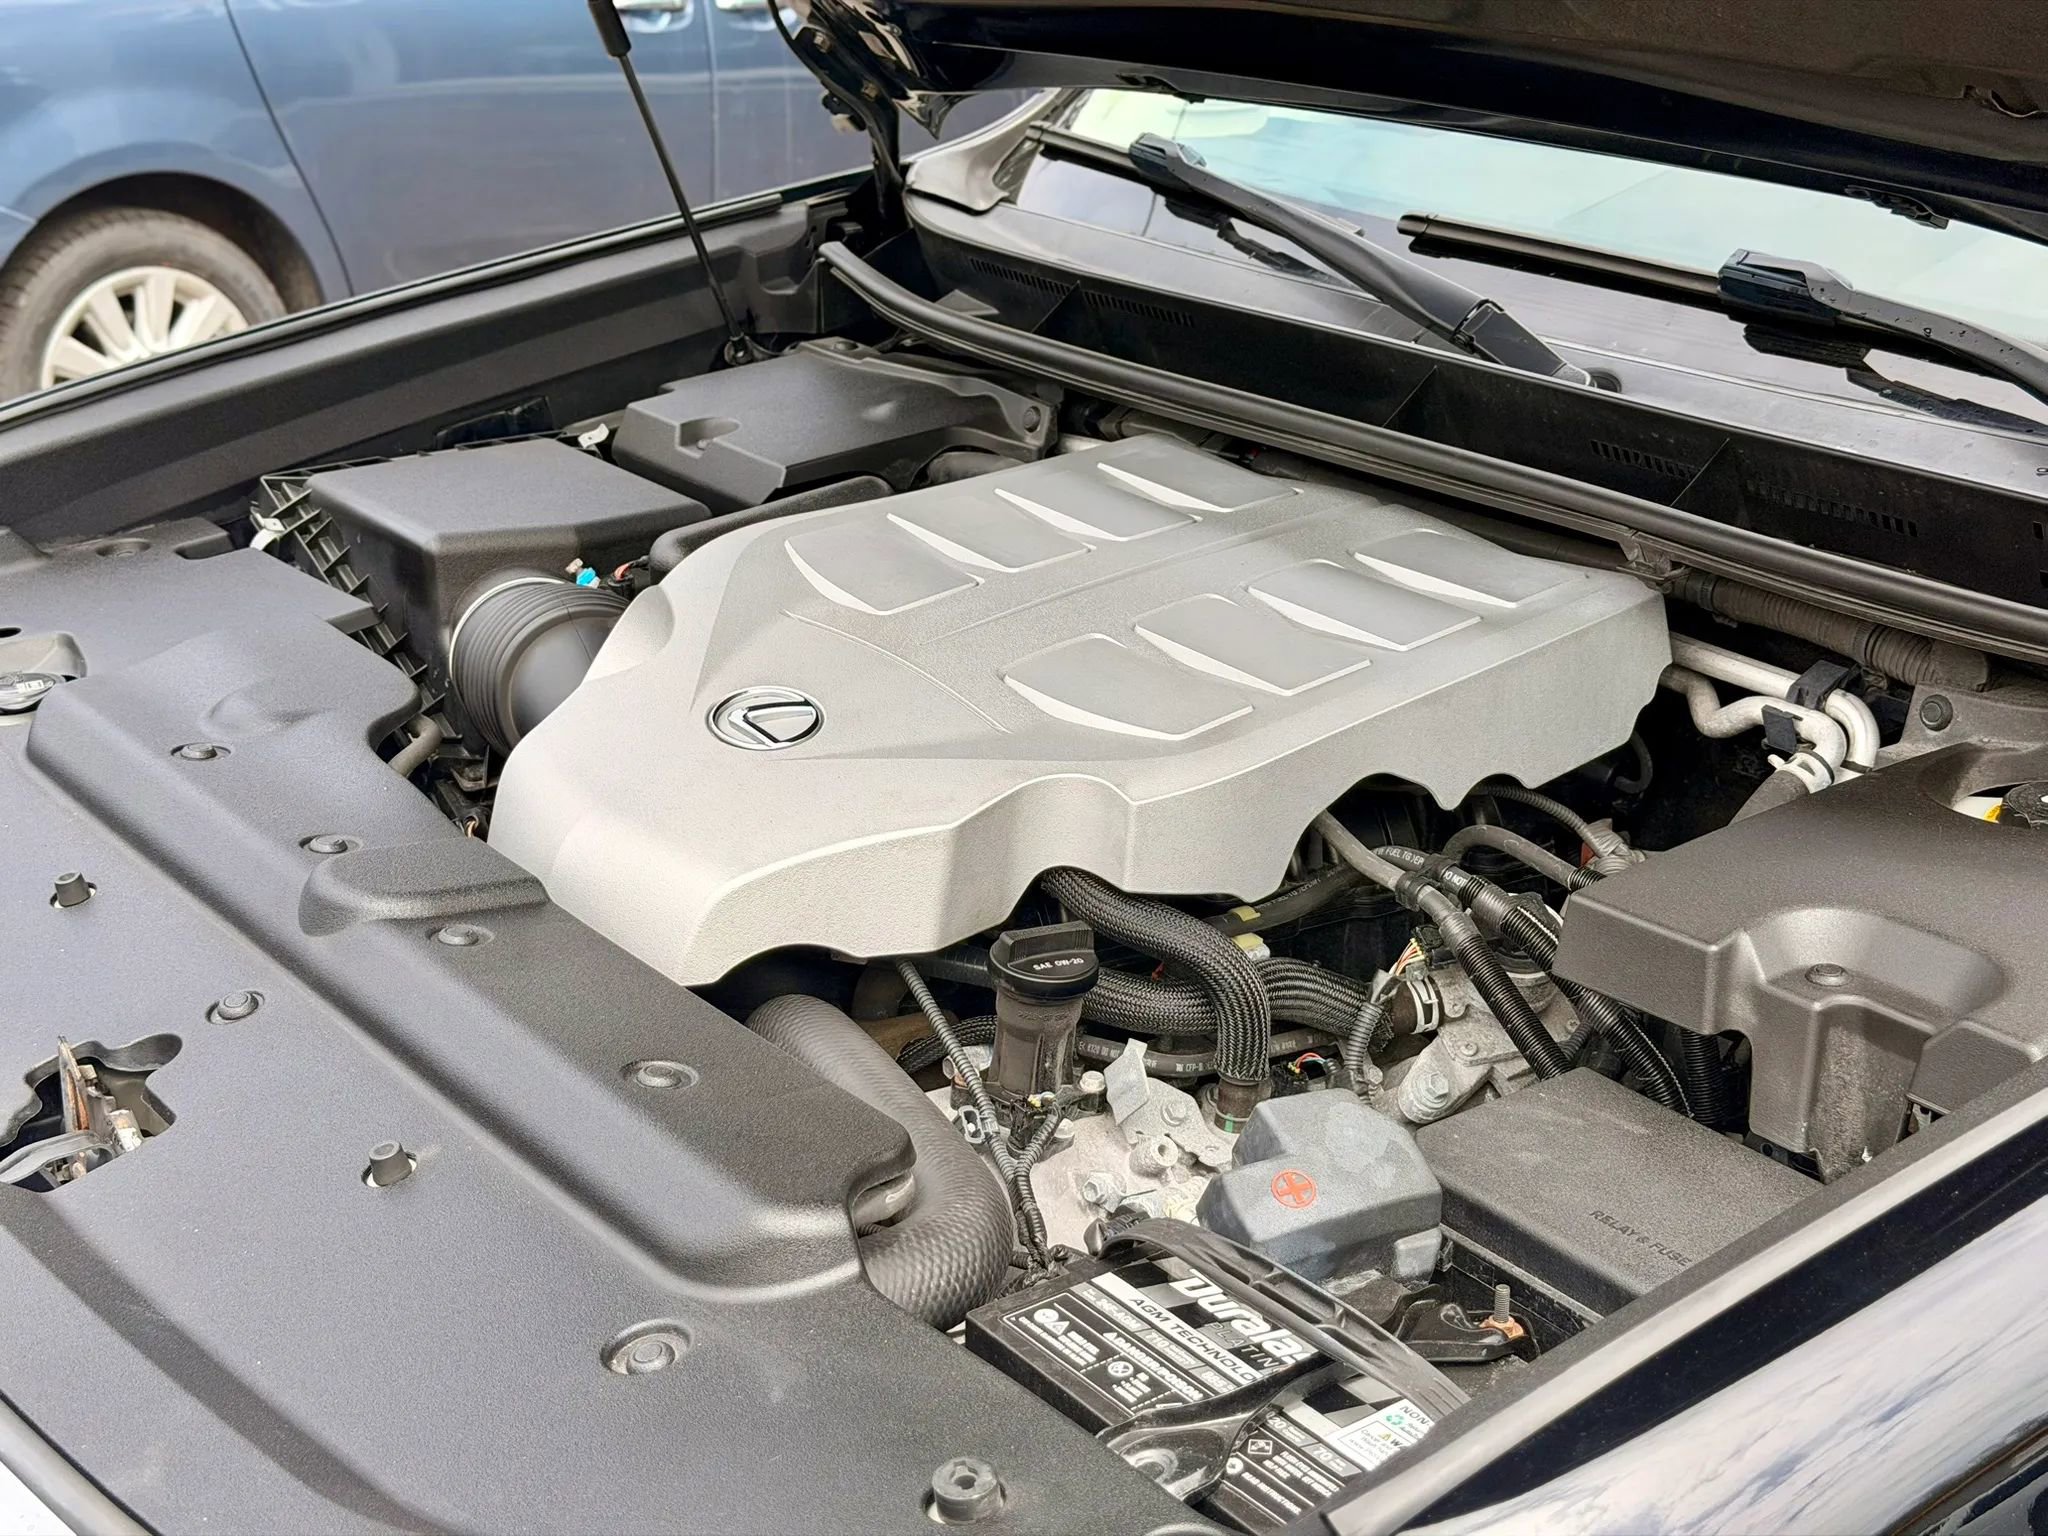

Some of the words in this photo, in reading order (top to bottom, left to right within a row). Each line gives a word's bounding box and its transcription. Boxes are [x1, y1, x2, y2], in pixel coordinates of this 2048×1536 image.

[1032, 962, 1053, 970] SAE
[1054, 957, 1084, 967] 0W-20
[1589, 1210, 1639, 1237] RELAY
[1649, 1242, 1693, 1266] FUSE
[1128, 1299, 1171, 1323] AGM
[1170, 1323, 1257, 1382] TECHNOLO
[1168, 1268, 1312, 1365] Duralas
[1204, 1321, 1280, 1370] PLATIN
[1313, 1446, 1333, 1460] 70
